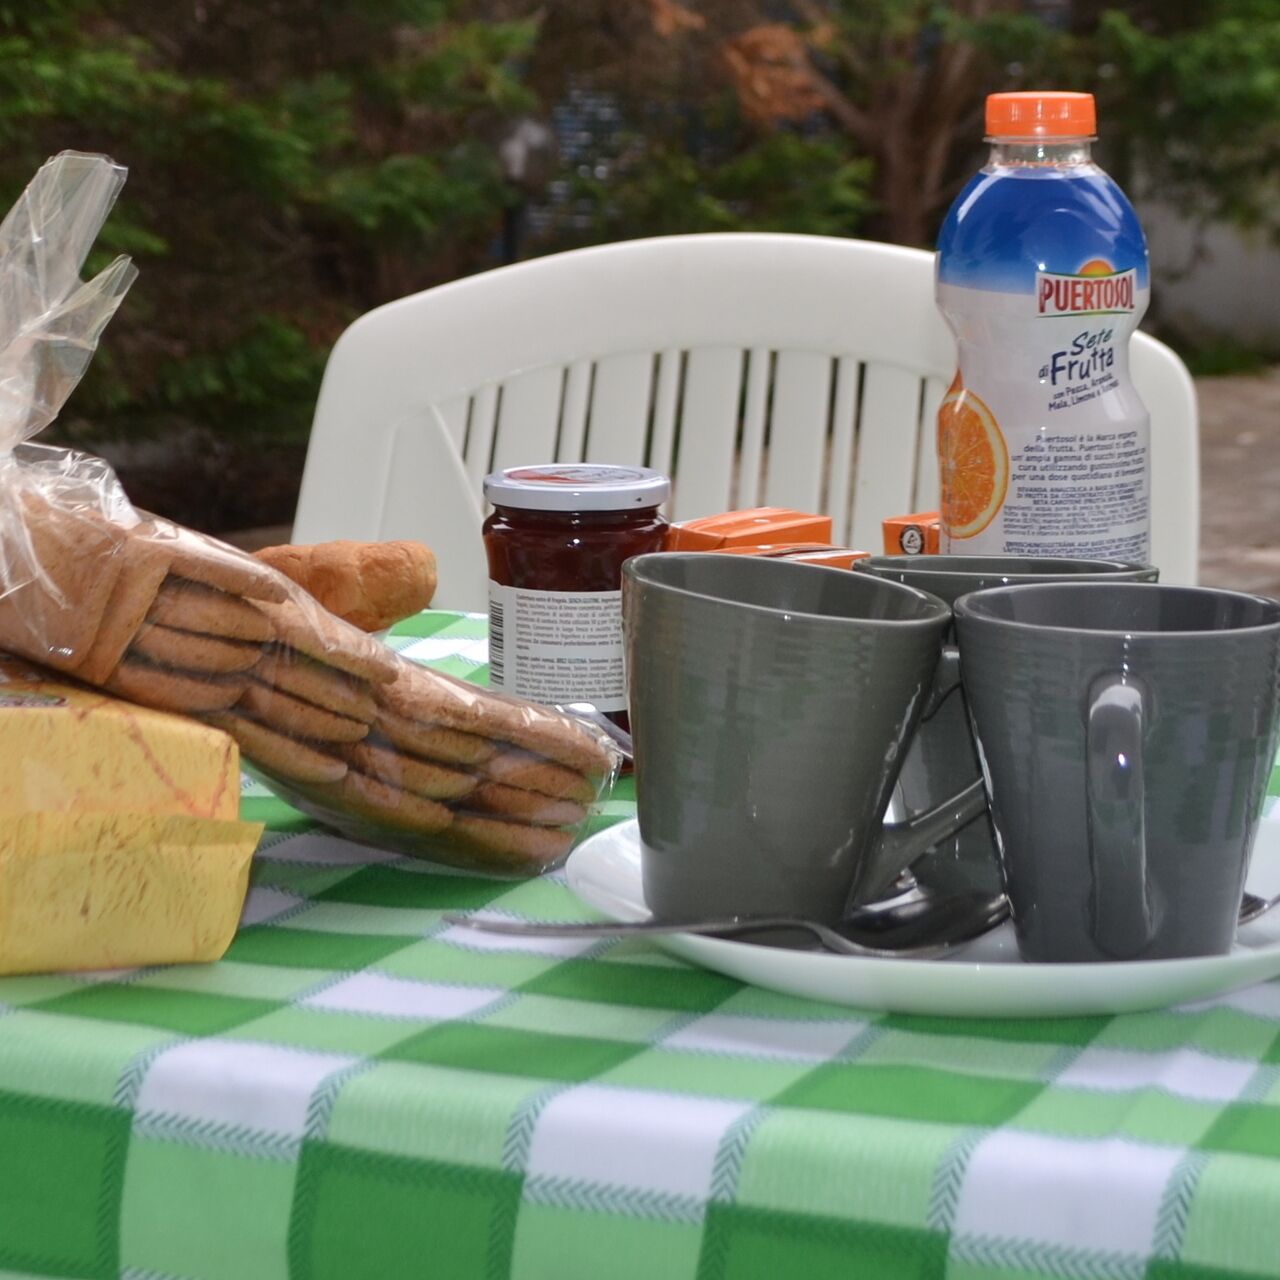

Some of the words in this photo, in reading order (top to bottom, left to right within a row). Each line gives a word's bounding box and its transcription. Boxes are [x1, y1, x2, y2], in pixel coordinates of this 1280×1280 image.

[1038, 274, 1136, 313] PUERTOSOL
[1070, 328, 1113, 356] Sete
[1038, 364, 1049, 379] di
[1051, 347, 1114, 386] Frutta
[1054, 455, 1082, 463] gamma
[1011, 473, 1026, 482] per
[1048, 473, 1068, 481] dose
